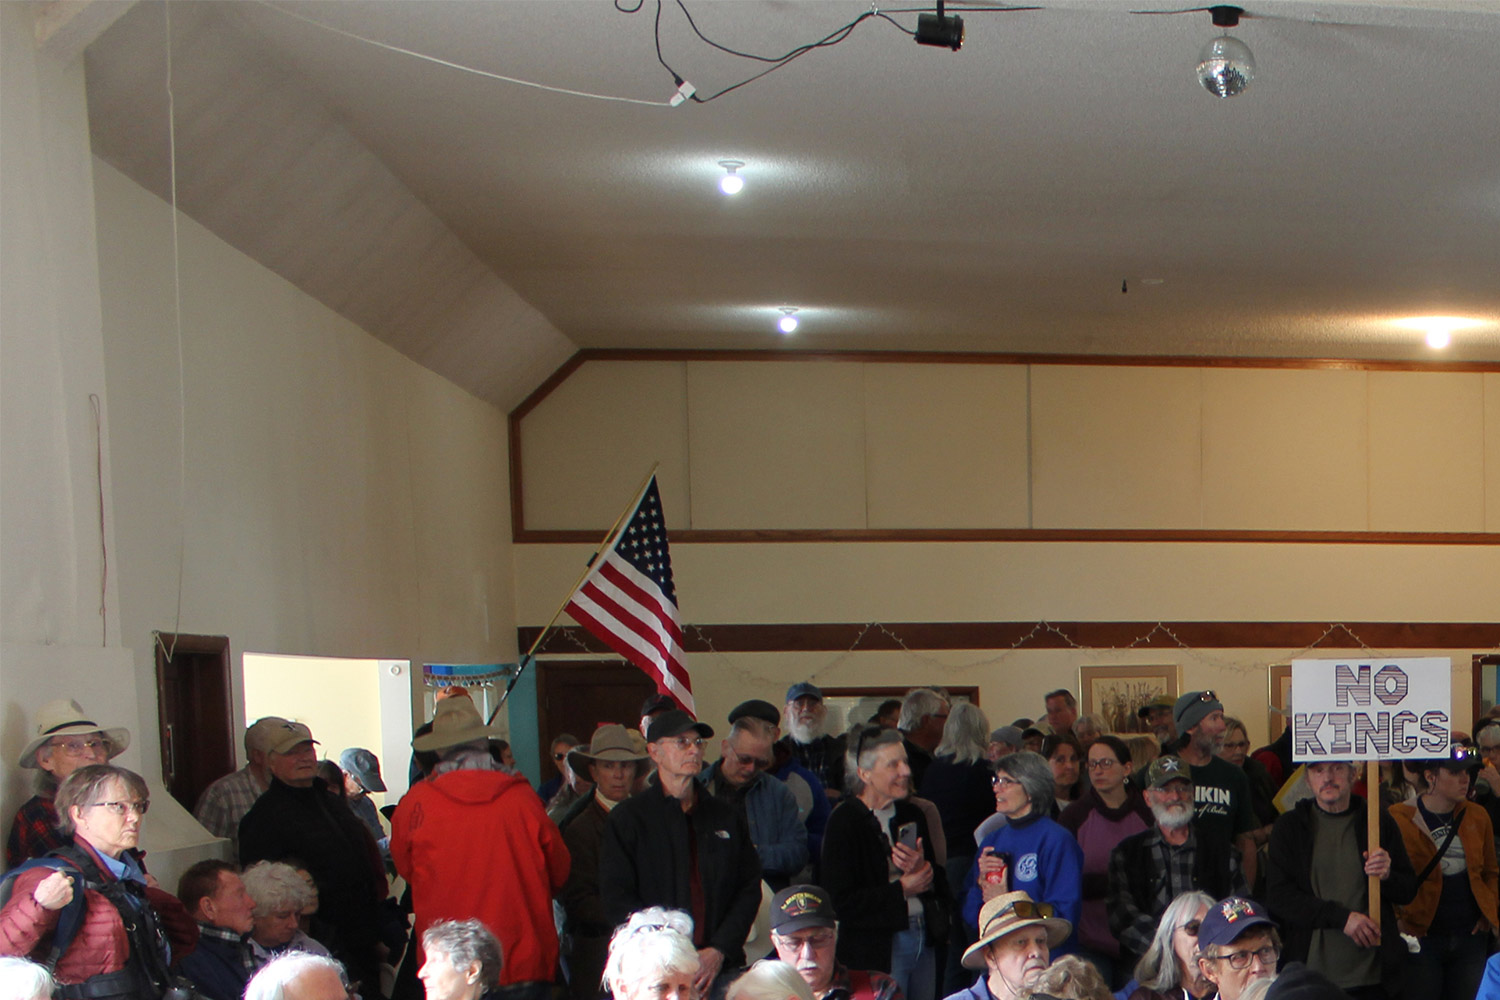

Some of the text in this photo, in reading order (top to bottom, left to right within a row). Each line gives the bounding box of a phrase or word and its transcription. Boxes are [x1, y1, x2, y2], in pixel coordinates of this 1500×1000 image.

[1335, 664, 1408, 707] NO
[1294, 709, 1449, 756] KINGS
[1194, 785, 1231, 806] IKIN
